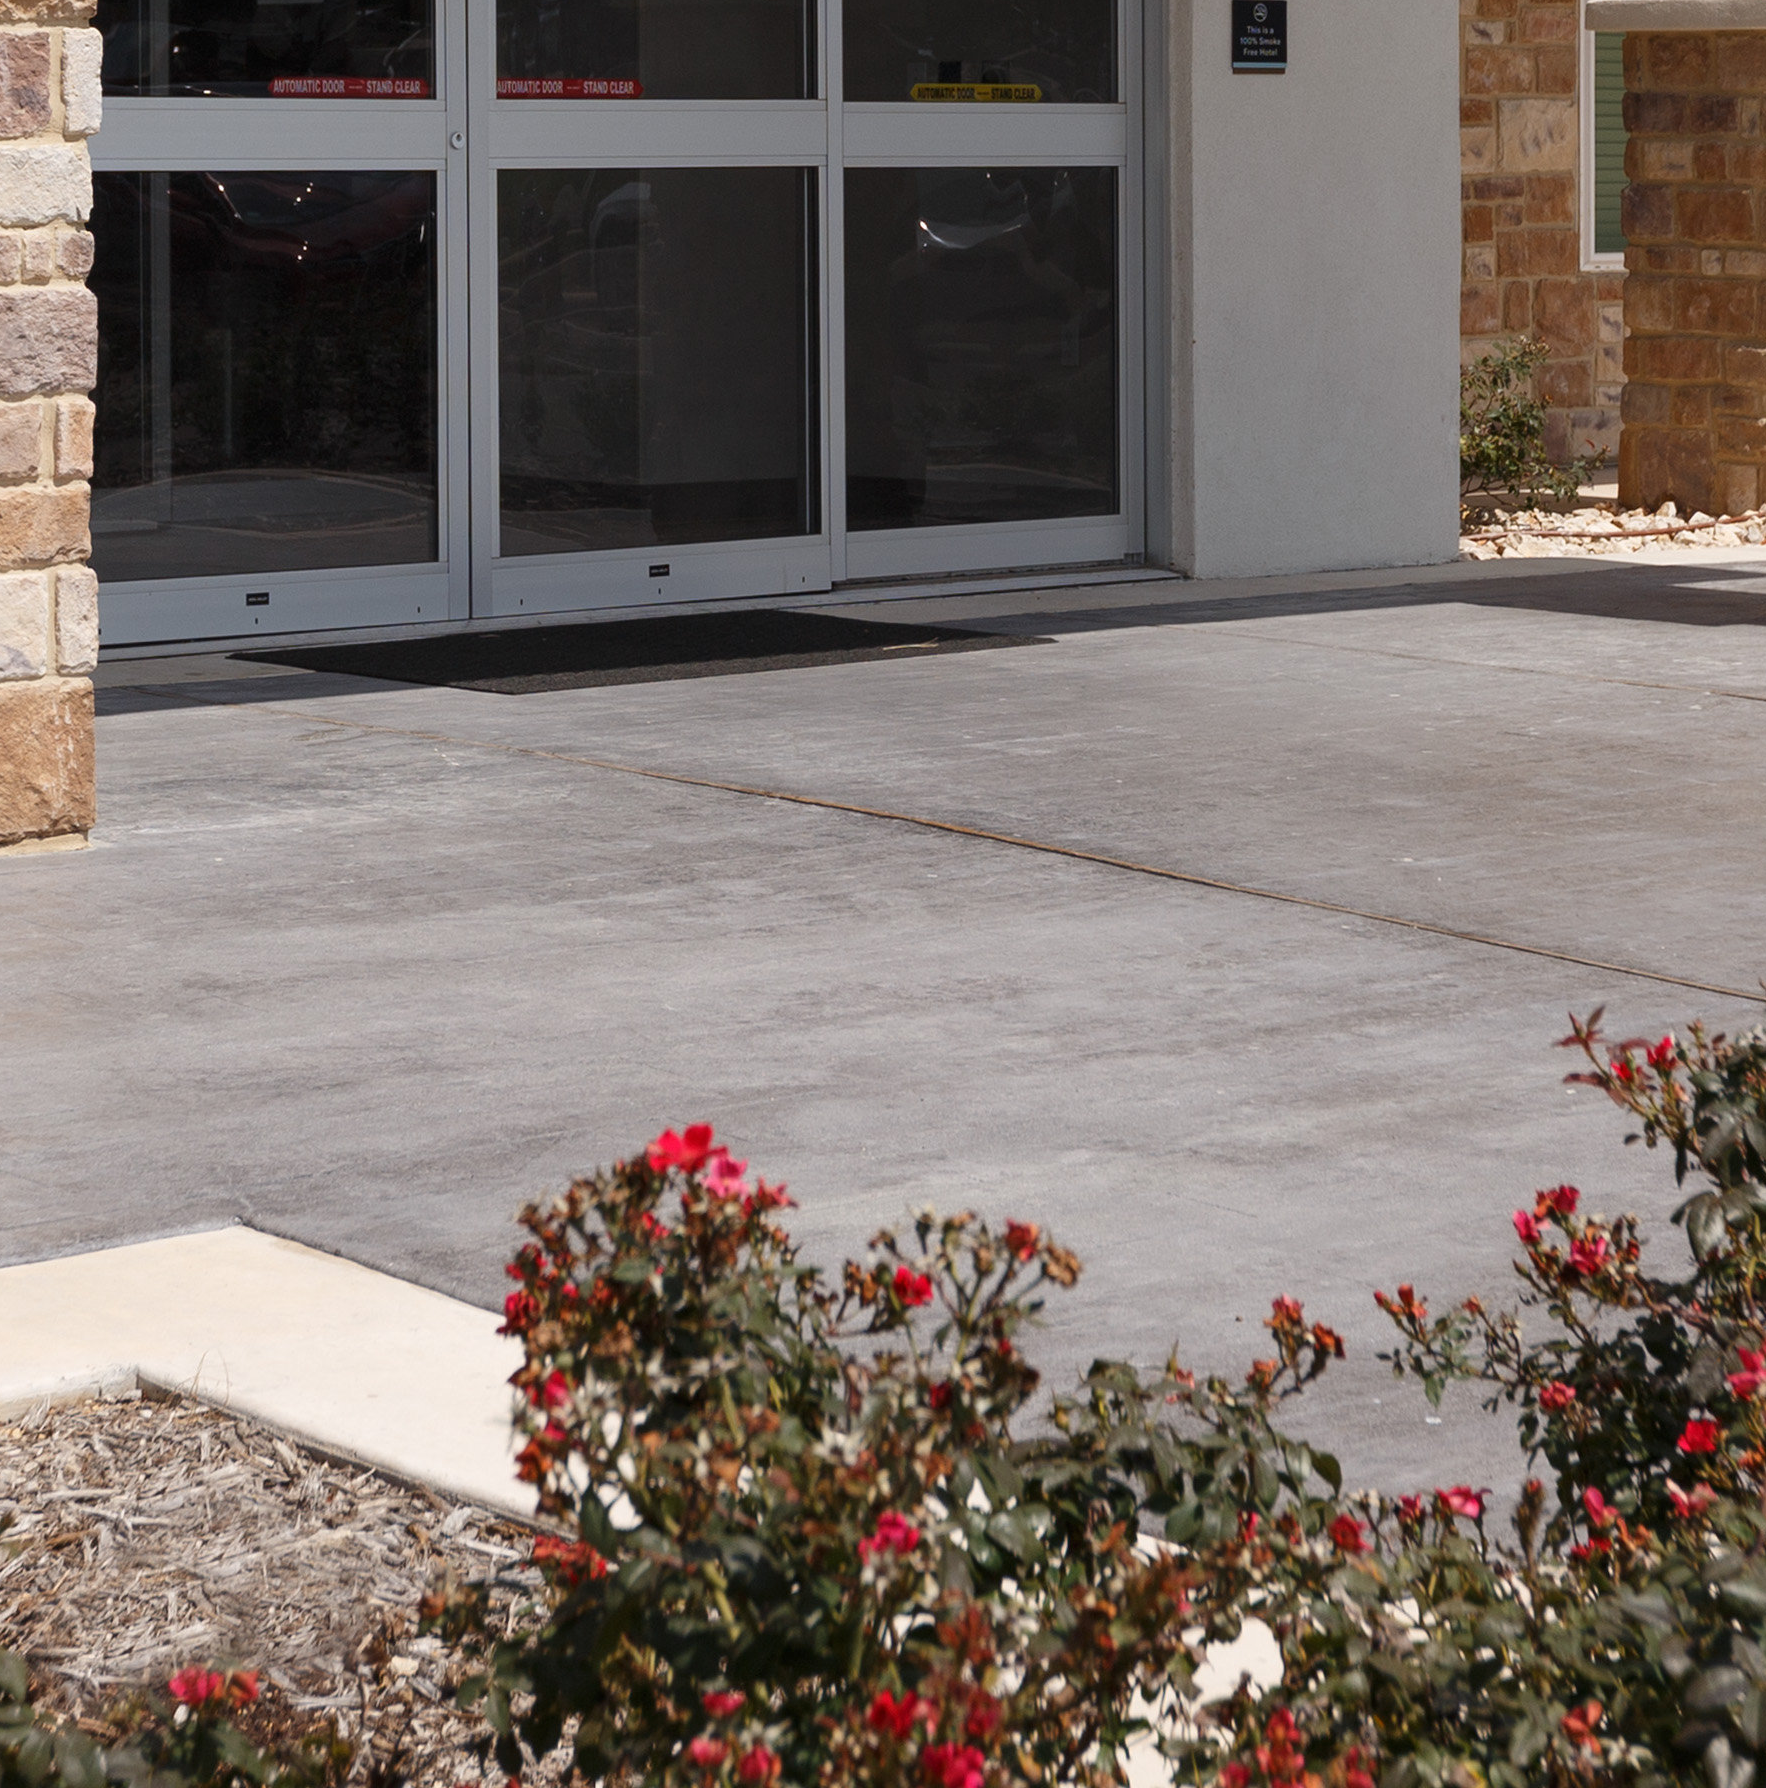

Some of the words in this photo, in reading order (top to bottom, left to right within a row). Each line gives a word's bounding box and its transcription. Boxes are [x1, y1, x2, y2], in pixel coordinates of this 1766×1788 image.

[1247, 25, 1261, 34] This
[1262, 25, 1269, 34] is
[1240, 37, 1258, 45] 100%
[1259, 37, 1281, 45] Smoke
[1243, 47, 1258, 56] Free
[1259, 48, 1278, 56] Hotel
[273, 79, 321, 94] AUTOMATIC
[322, 80, 345, 94] DOOR
[366, 80, 393, 94] STAND
[394, 81, 420, 94] CLEAR
[497, 80, 541, 94] AUTOMATIC
[542, 80, 563, 94] DOOR
[583, 80, 608, 94] STAND
[609, 81, 634, 94] CLEAR
[917, 87, 955, 99] AUTOMATIC
[957, 87, 975, 99] DOOR
[991, 88, 1013, 99] STAND
[1014, 88, 1035, 100] CLEAR
